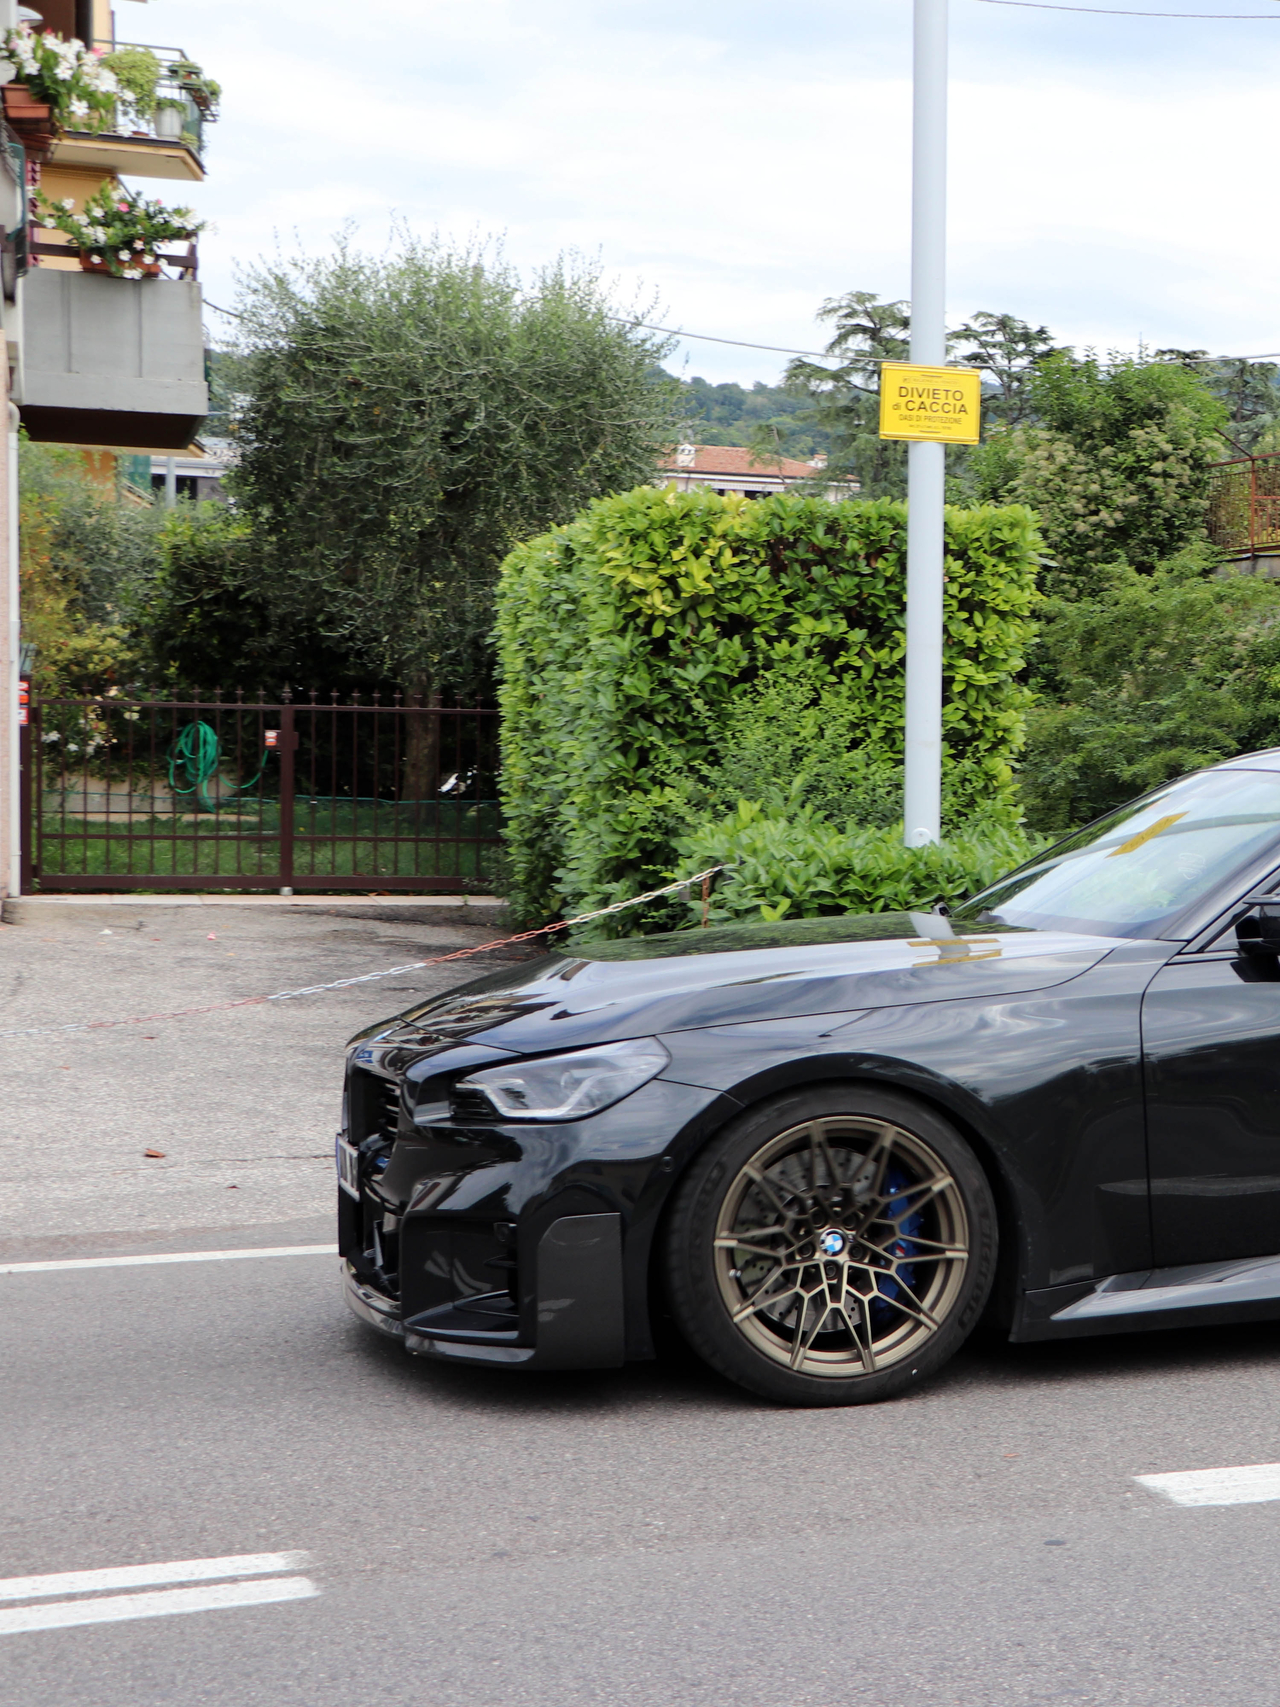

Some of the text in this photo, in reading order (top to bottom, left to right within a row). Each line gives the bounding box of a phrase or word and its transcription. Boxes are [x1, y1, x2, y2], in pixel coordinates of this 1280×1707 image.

[898, 386, 964, 402] DIVIETO
[892, 400, 969, 415] di CACCIA
[898, 414, 914, 422] OASI
[924, 415, 962, 425] PROTEZIONE
